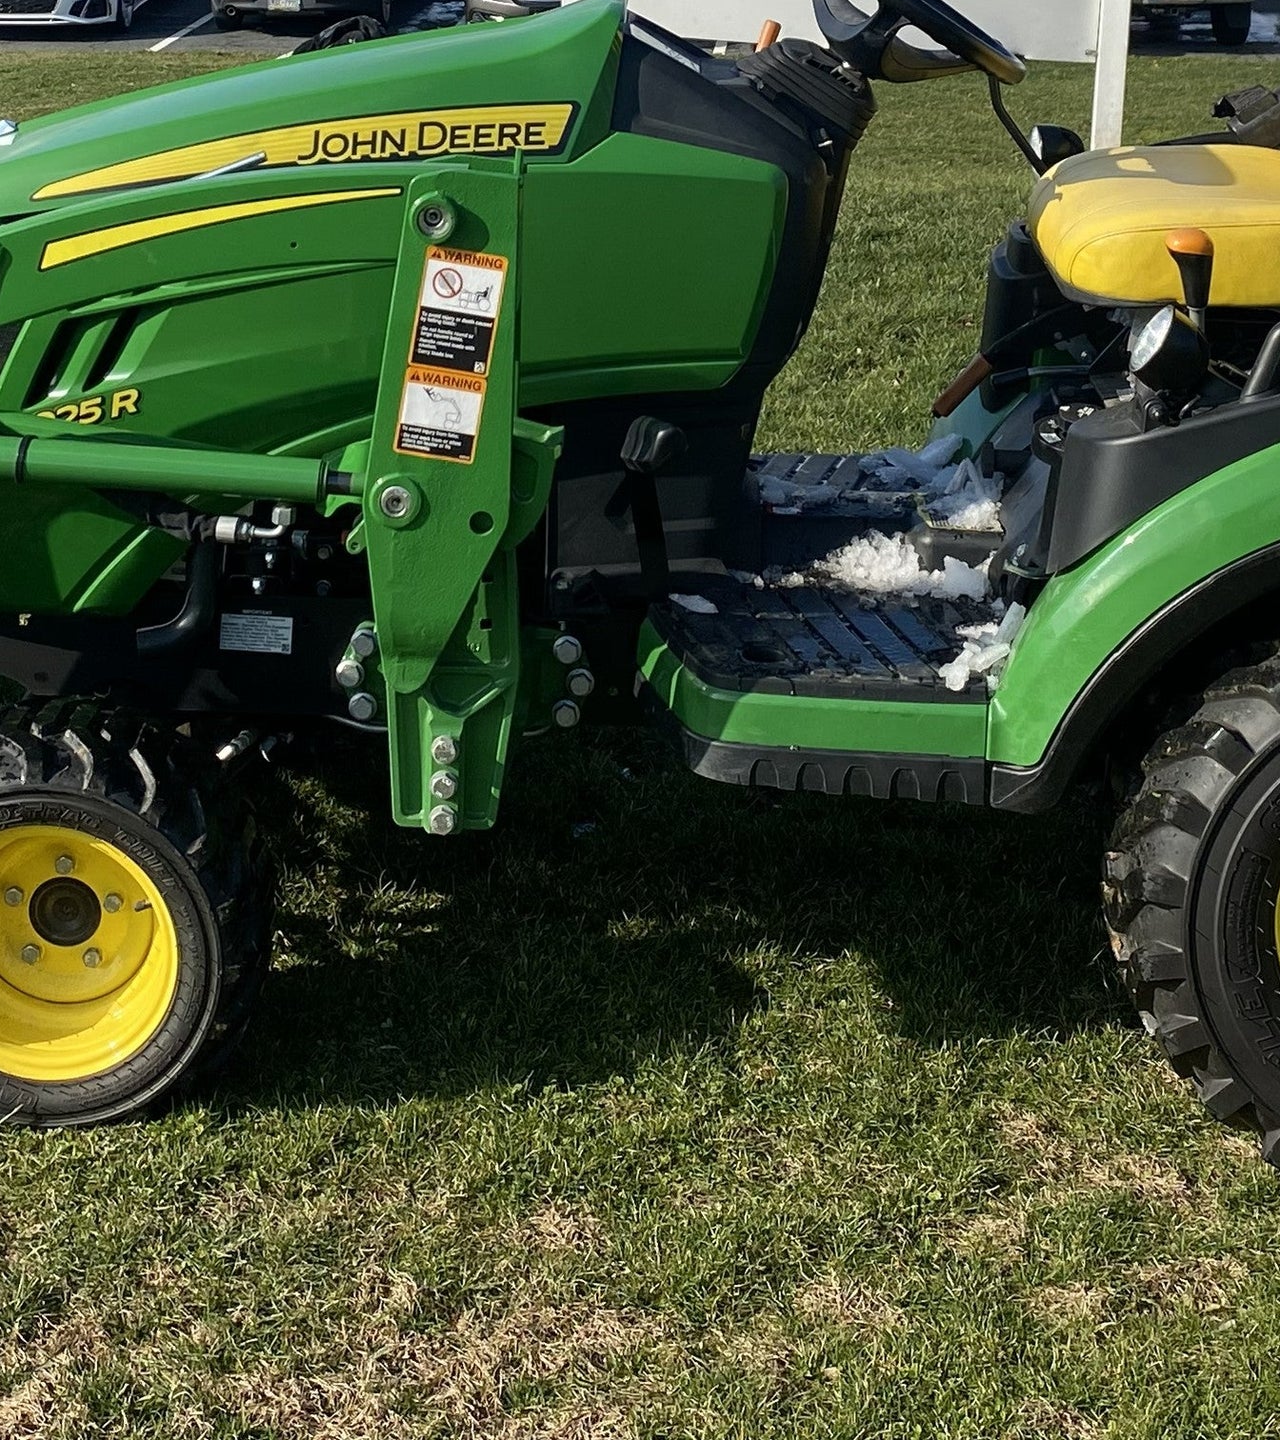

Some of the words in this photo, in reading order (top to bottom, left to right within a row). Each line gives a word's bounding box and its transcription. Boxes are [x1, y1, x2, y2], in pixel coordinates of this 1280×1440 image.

[297, 128, 407, 161] JOHN
[417, 121, 548, 152] DEERE
[443, 249, 504, 270] WARNING
[422, 371, 482, 392] WARNING
[36, 397, 103, 425] 25
[110, 388, 139, 418] R
